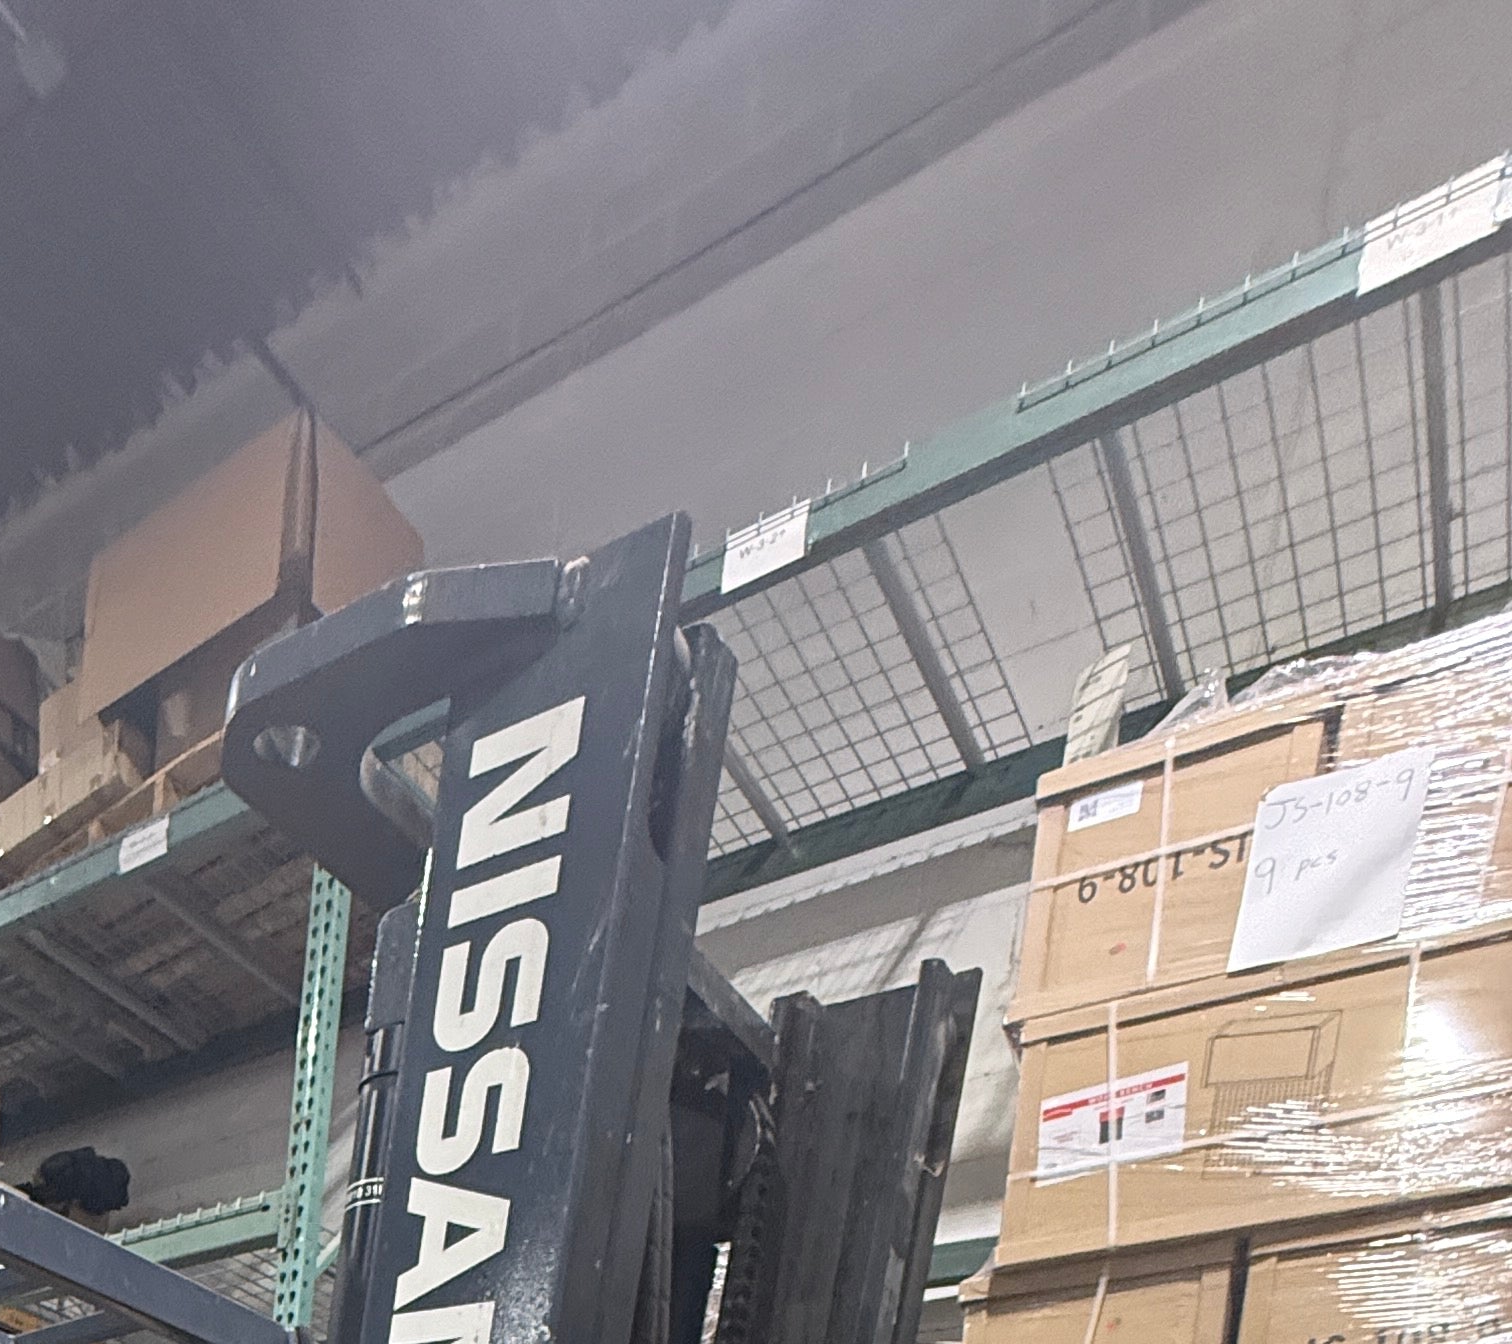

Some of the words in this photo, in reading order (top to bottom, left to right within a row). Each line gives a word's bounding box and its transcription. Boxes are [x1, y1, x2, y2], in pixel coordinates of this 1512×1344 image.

[1264, 768, 1415, 830] JS-108-9
[1254, 857, 1276, 894] 9
[1294, 849, 1338, 881] pcs
